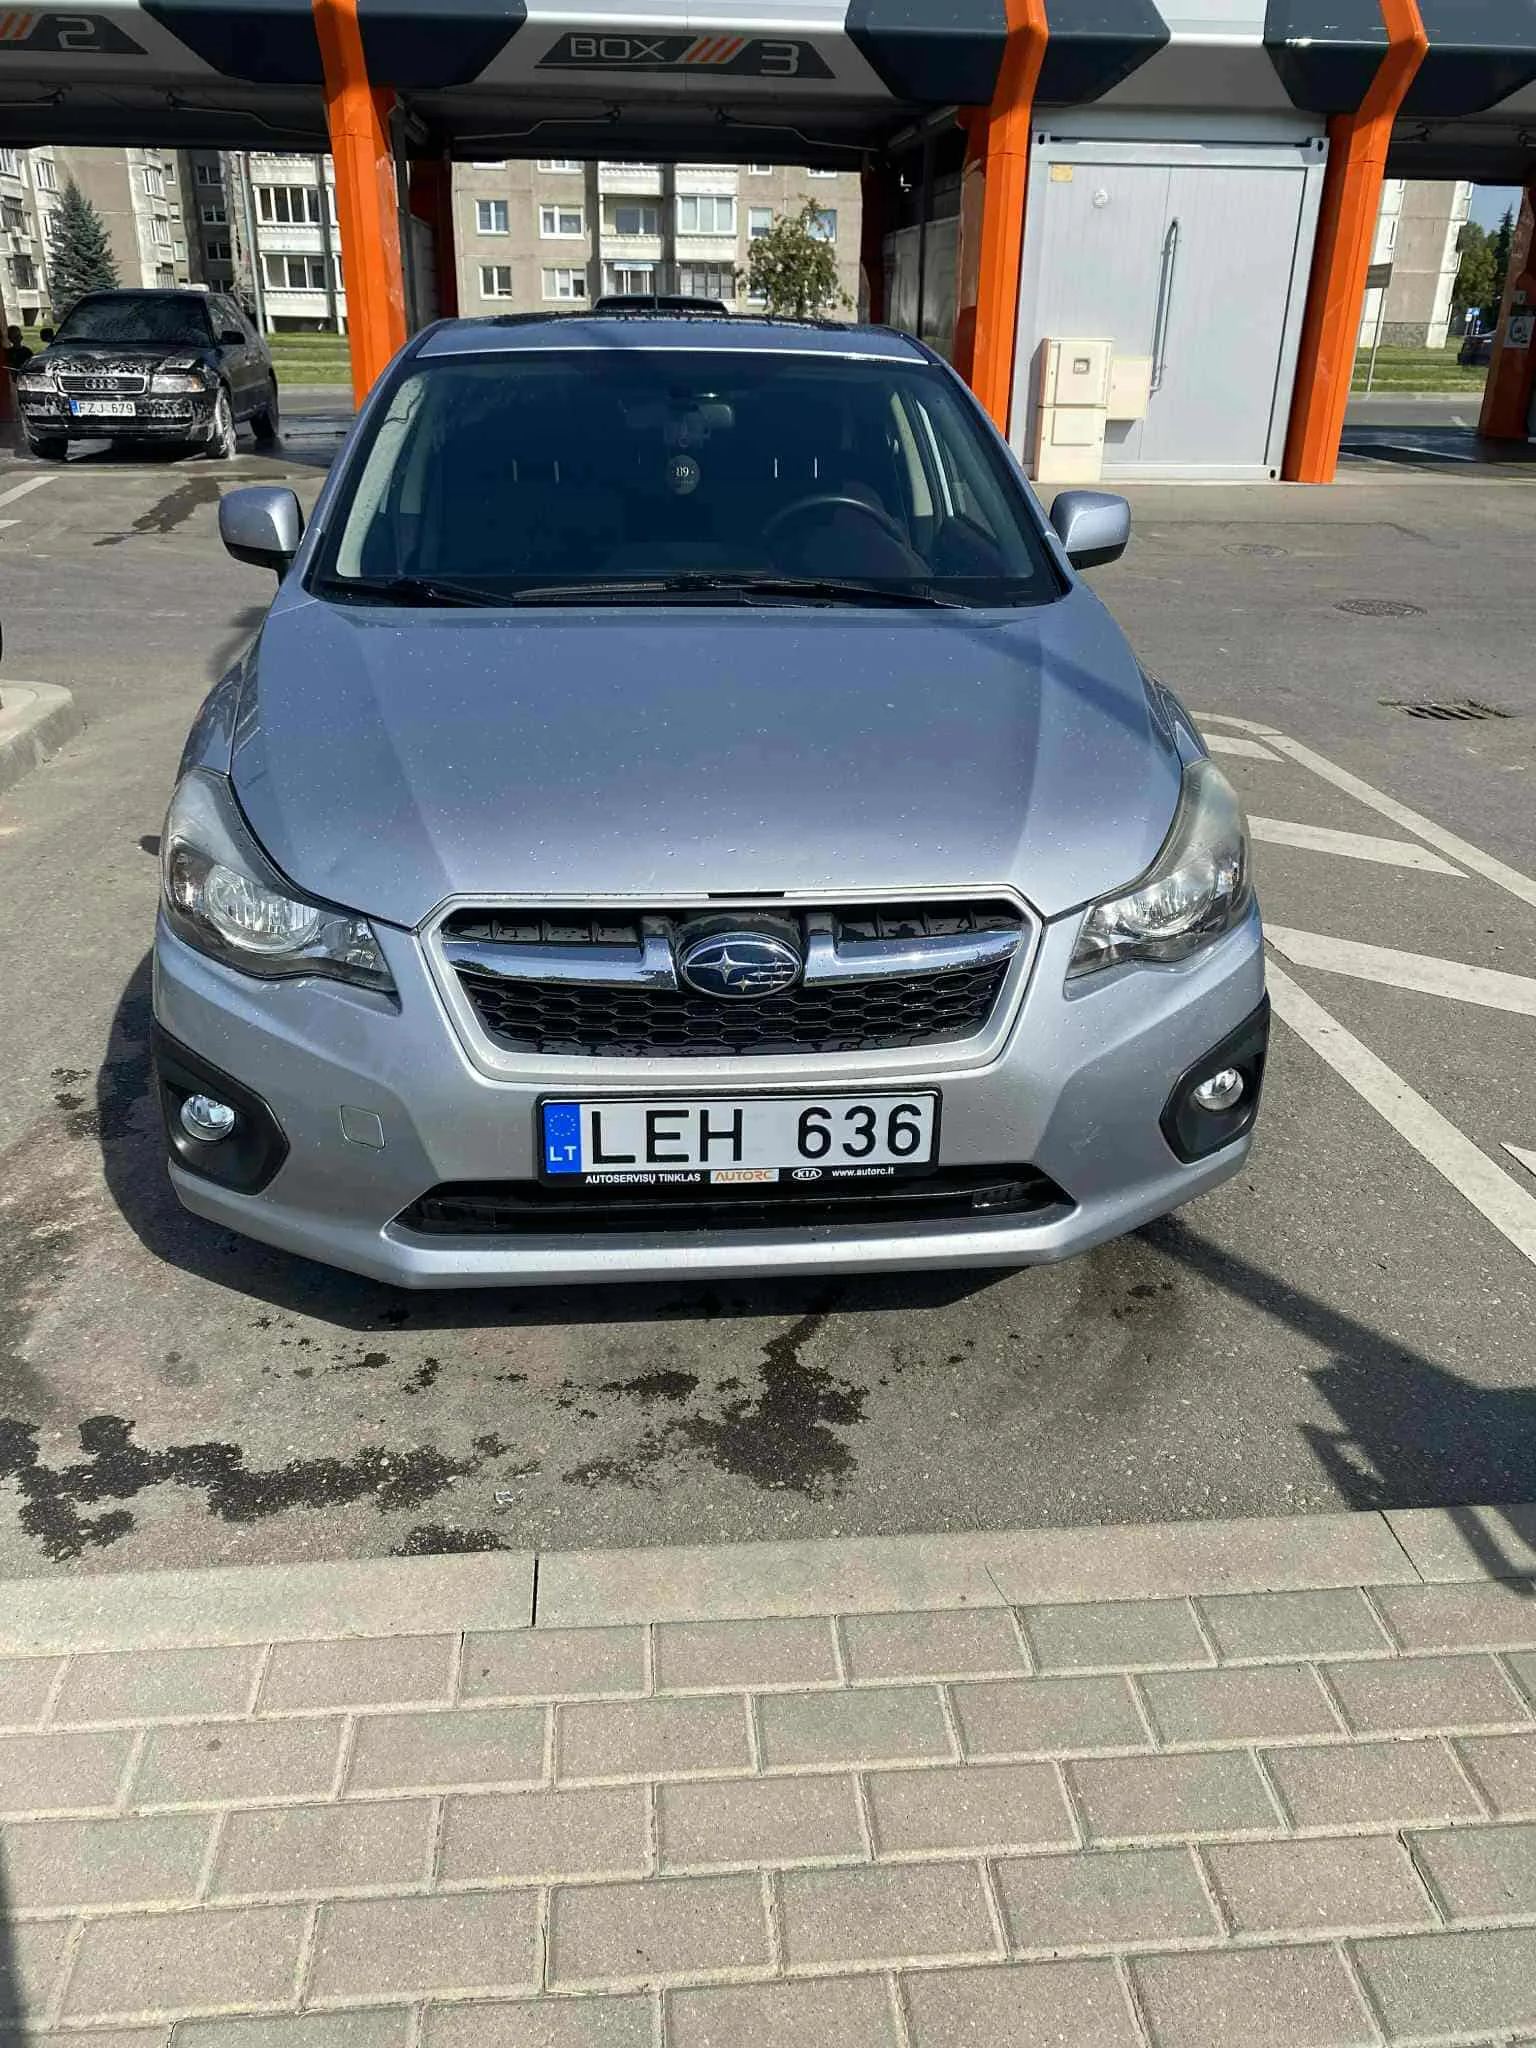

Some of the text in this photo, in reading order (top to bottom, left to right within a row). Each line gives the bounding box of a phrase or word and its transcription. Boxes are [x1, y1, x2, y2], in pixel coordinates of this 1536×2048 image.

[56, 17, 101, 50] 2
[570, 37, 800, 75] BOX 3
[591, 1103, 922, 1164] LEH 636
[549, 1145, 577, 1162] LT
[658, 1173, 701, 1183] TINKLAS
[796, 1168, 819, 1179] KIA
